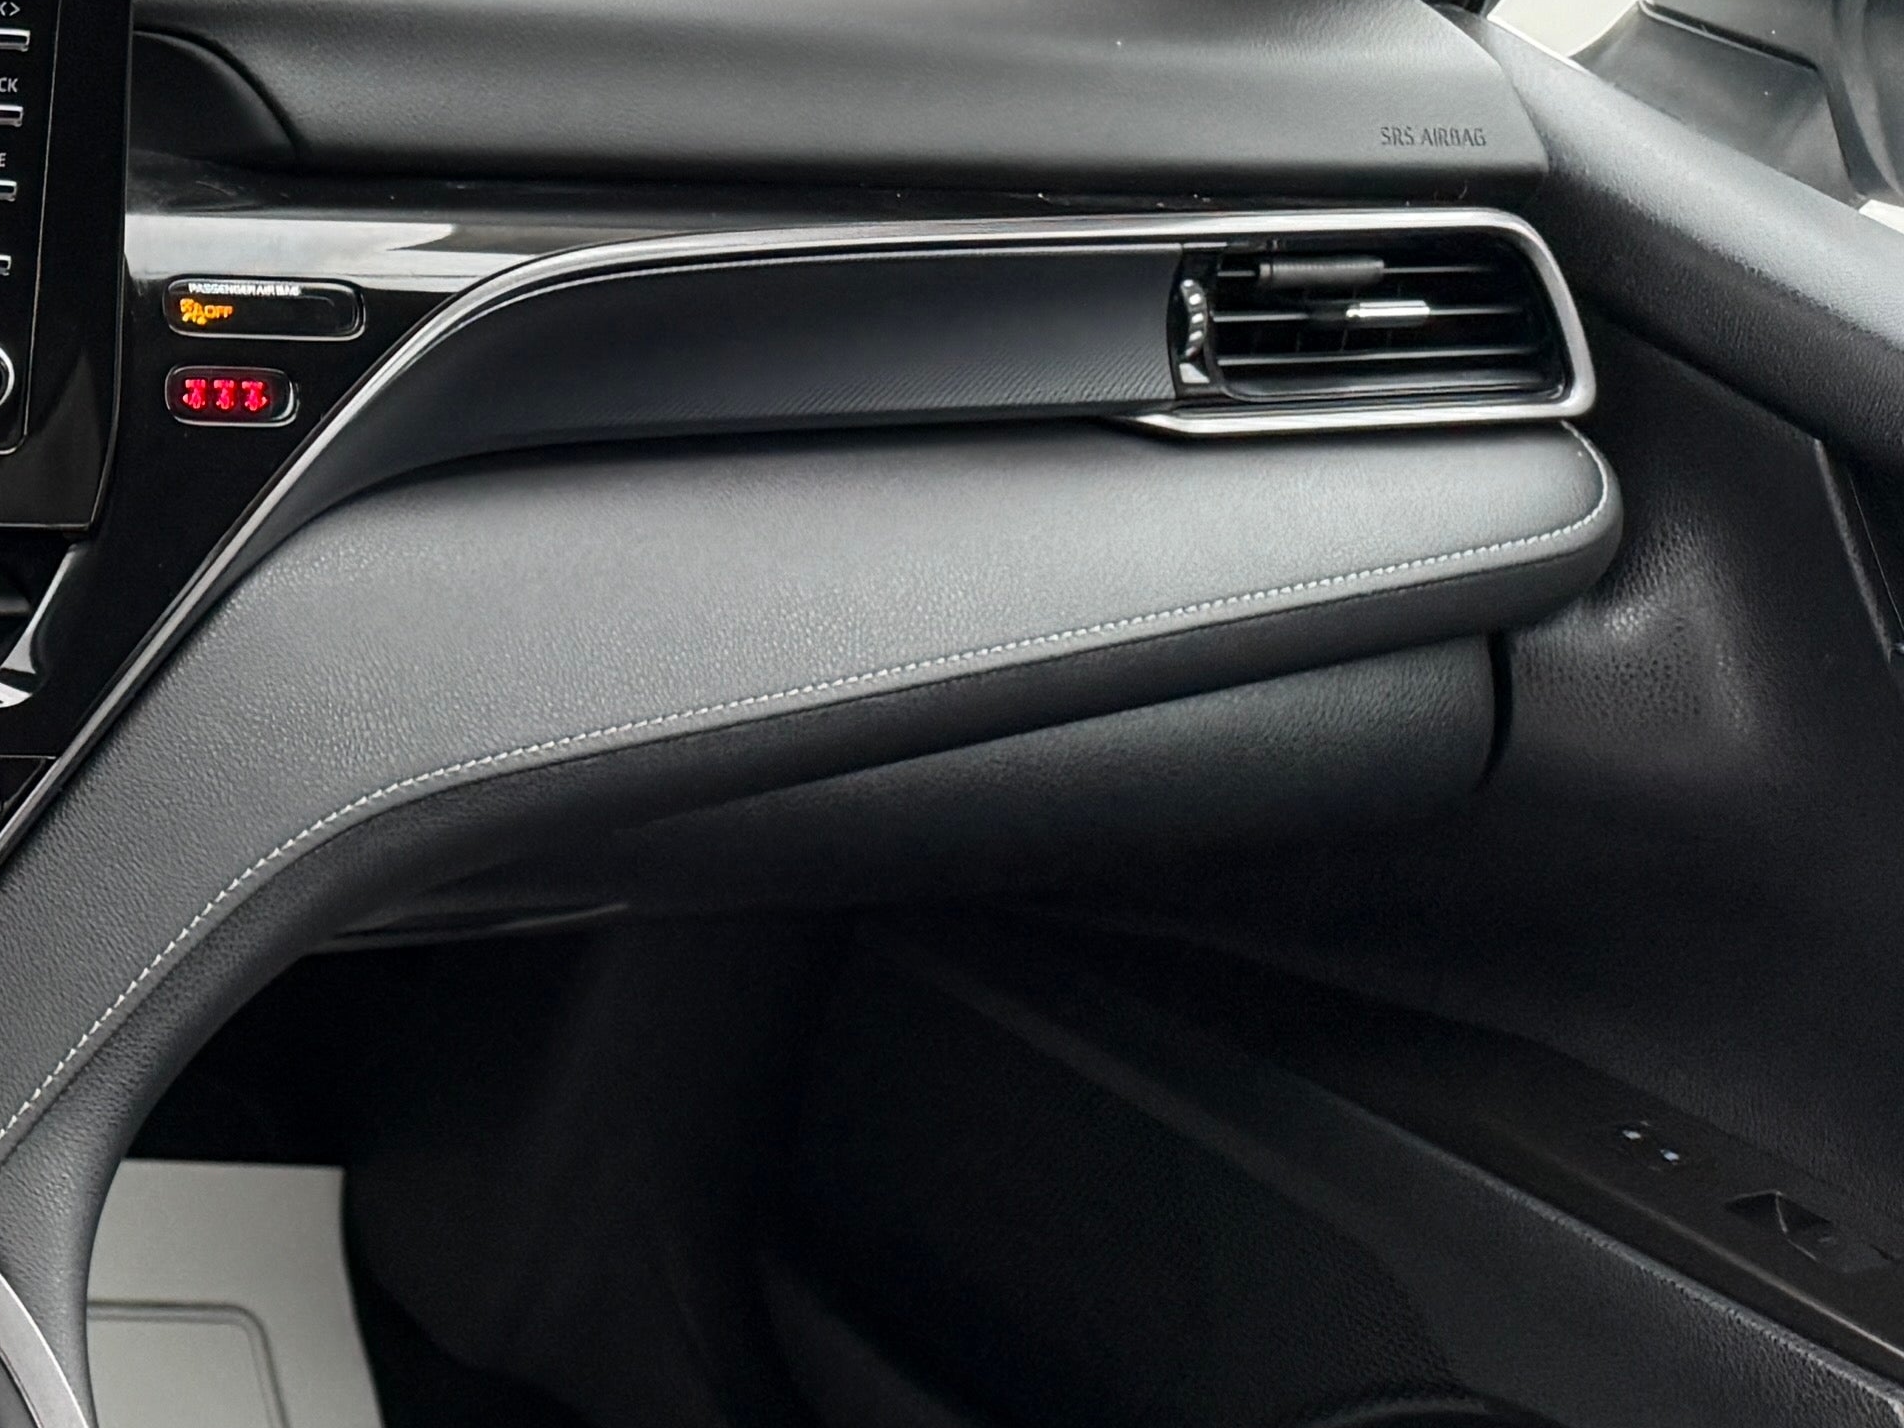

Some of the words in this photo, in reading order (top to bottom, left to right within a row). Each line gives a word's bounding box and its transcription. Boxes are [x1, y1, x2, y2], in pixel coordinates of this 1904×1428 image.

[1380, 126, 1415, 146] SRS
[1421, 128, 1487, 147] AIRBAG
[204, 304, 234, 319] OFF
